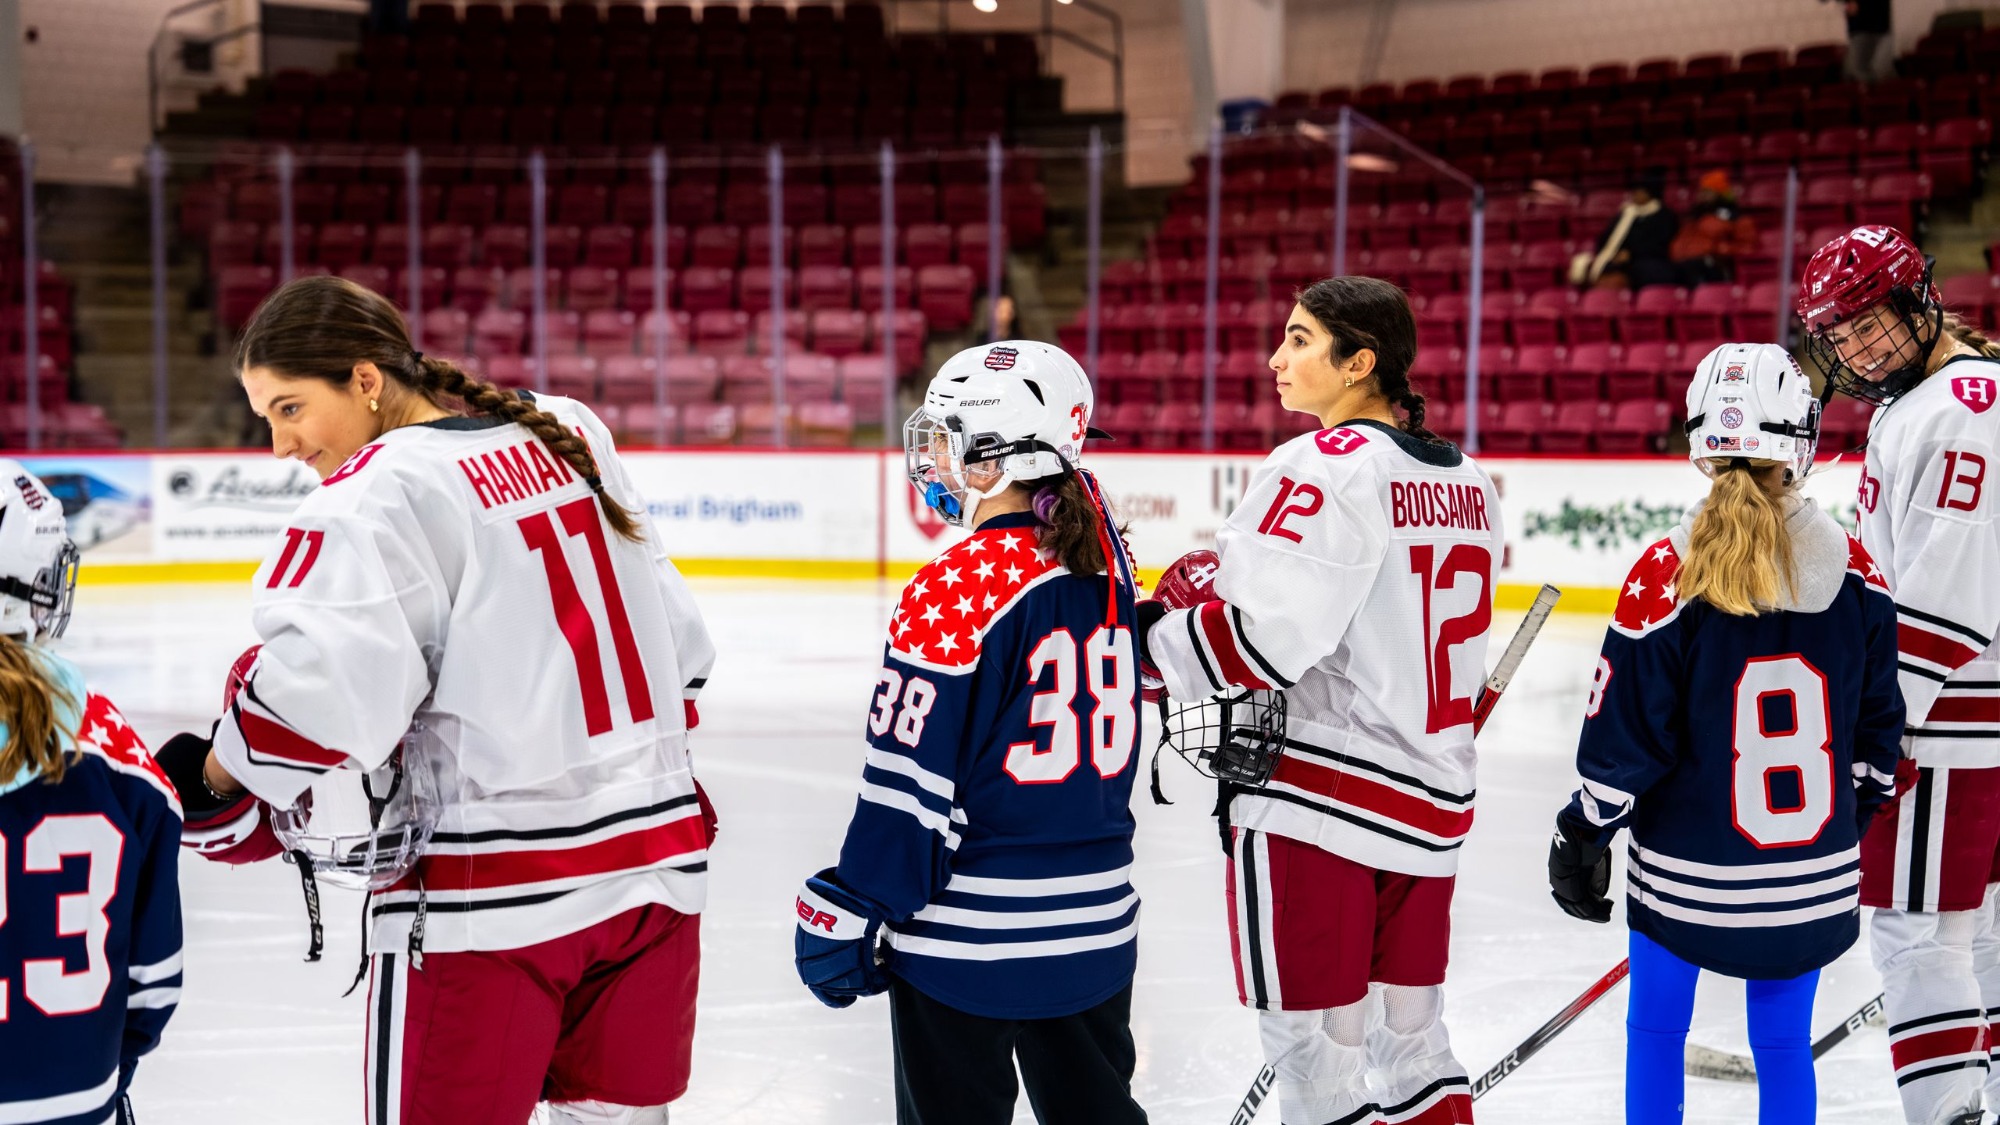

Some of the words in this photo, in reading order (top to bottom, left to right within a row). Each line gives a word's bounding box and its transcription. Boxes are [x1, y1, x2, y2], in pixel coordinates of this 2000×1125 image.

[959, 398, 1001, 407] BAUER
[1960, 379, 1989, 405] H
[457, 425, 601, 510] HAMA
[1320, 427, 1356, 451] H
[1257, 476, 1324, 544] 12
[1390, 481, 1491, 531] BOOSAMR
[1936, 450, 1986, 512] 13
[266, 527, 325, 589] 11
[1188, 561, 1218, 590] H
[517, 496, 655, 737] 11
[1409, 544, 1492, 734] 12
[869, 666, 937, 748] 38
[1002, 624, 1137, 785] 38
[1731, 652, 1835, 849] 8
[0, 813, 126, 1023] 3
[795, 895, 838, 933] ER
